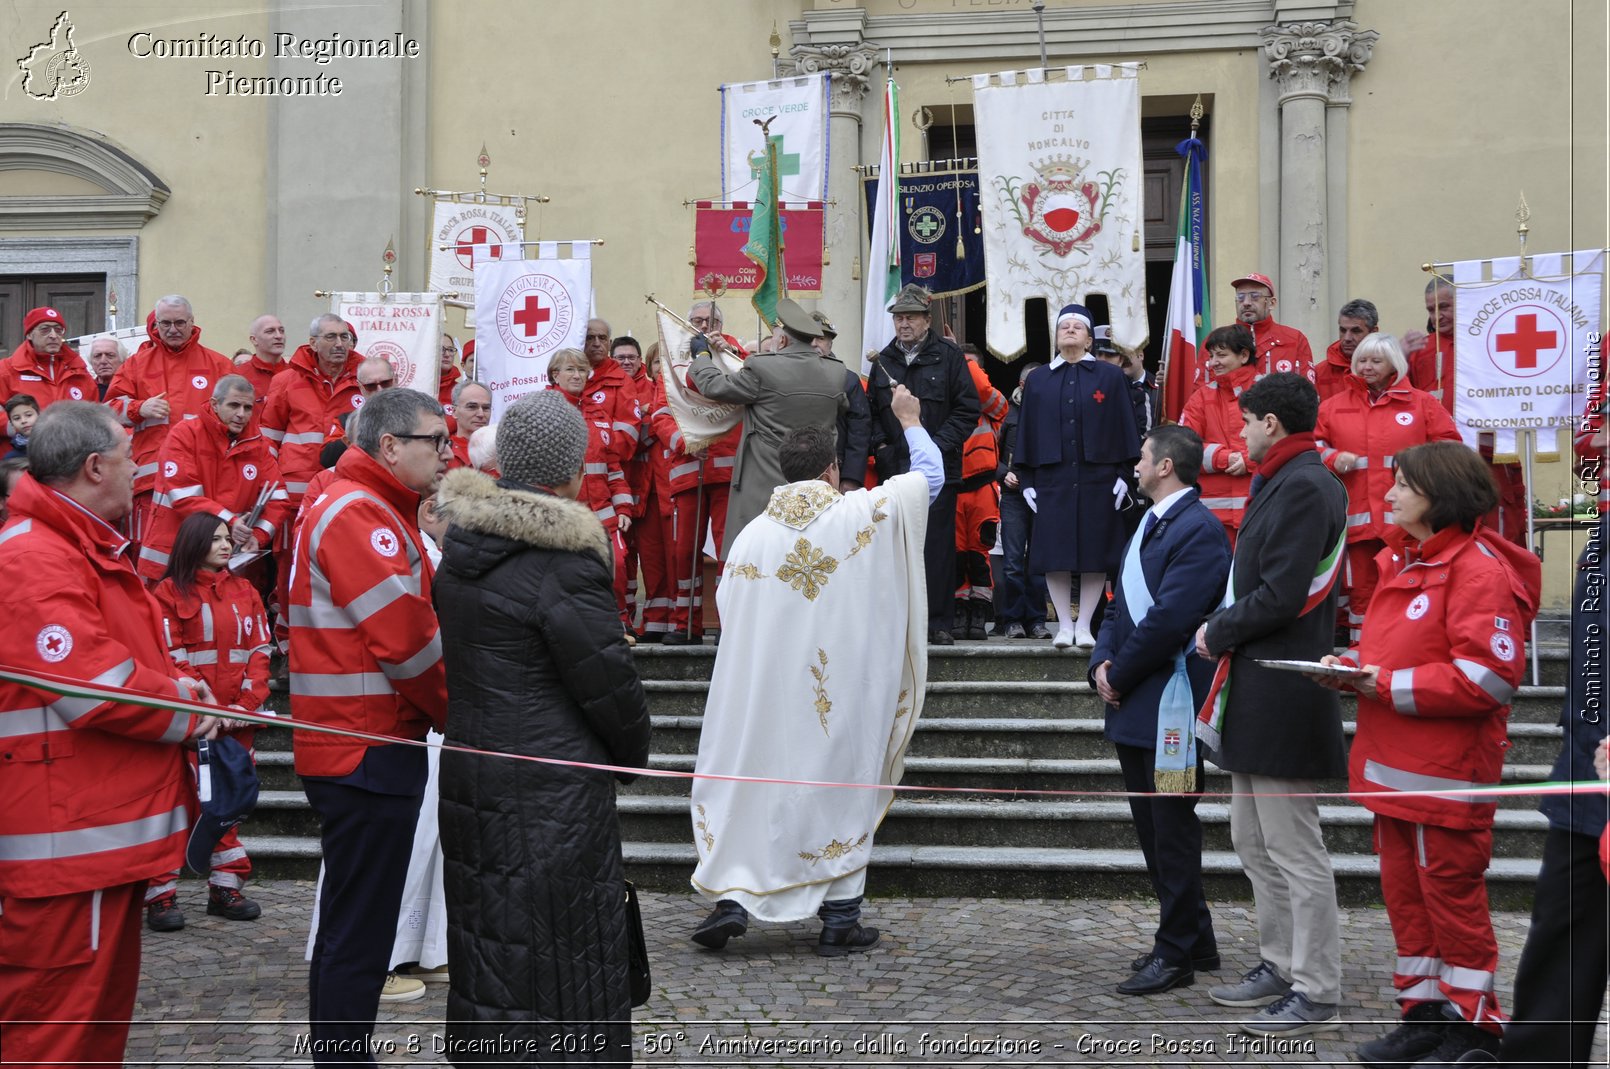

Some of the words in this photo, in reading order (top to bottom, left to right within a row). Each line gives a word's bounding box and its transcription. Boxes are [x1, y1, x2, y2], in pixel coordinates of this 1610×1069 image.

[742, 106, 774, 119] CROCE
[778, 102, 809, 113] VERDE
[1053, 124, 1064, 133] DI
[1027, 137, 1090, 151] MONCALVO
[898, 183, 934, 194] SILENZIO
[937, 180, 976, 191] OPEROSA
[438, 213, 460, 241] CROCE
[460, 208, 487, 221] ROSSA
[489, 211, 519, 243] ITALIAN
[347, 306, 385, 318] CROCE
[392, 307, 431, 318] ROSSA
[516, 276, 554, 292] GINEVRA
[553, 305, 568, 342] AGOSTO
[1468, 298, 1502, 337] CROCE
[1500, 287, 1542, 305] ROSSA
[1544, 289, 1589, 330] ITALIANA
[360, 321, 416, 331] ITALIANA
[512, 374, 538, 387] Rossa
[1467, 386, 1532, 398] COMITATO
[1536, 384, 1584, 396] LOCALE
[1520, 402, 1533, 411] DI
[1466, 417, 1543, 428] COCCONATO
